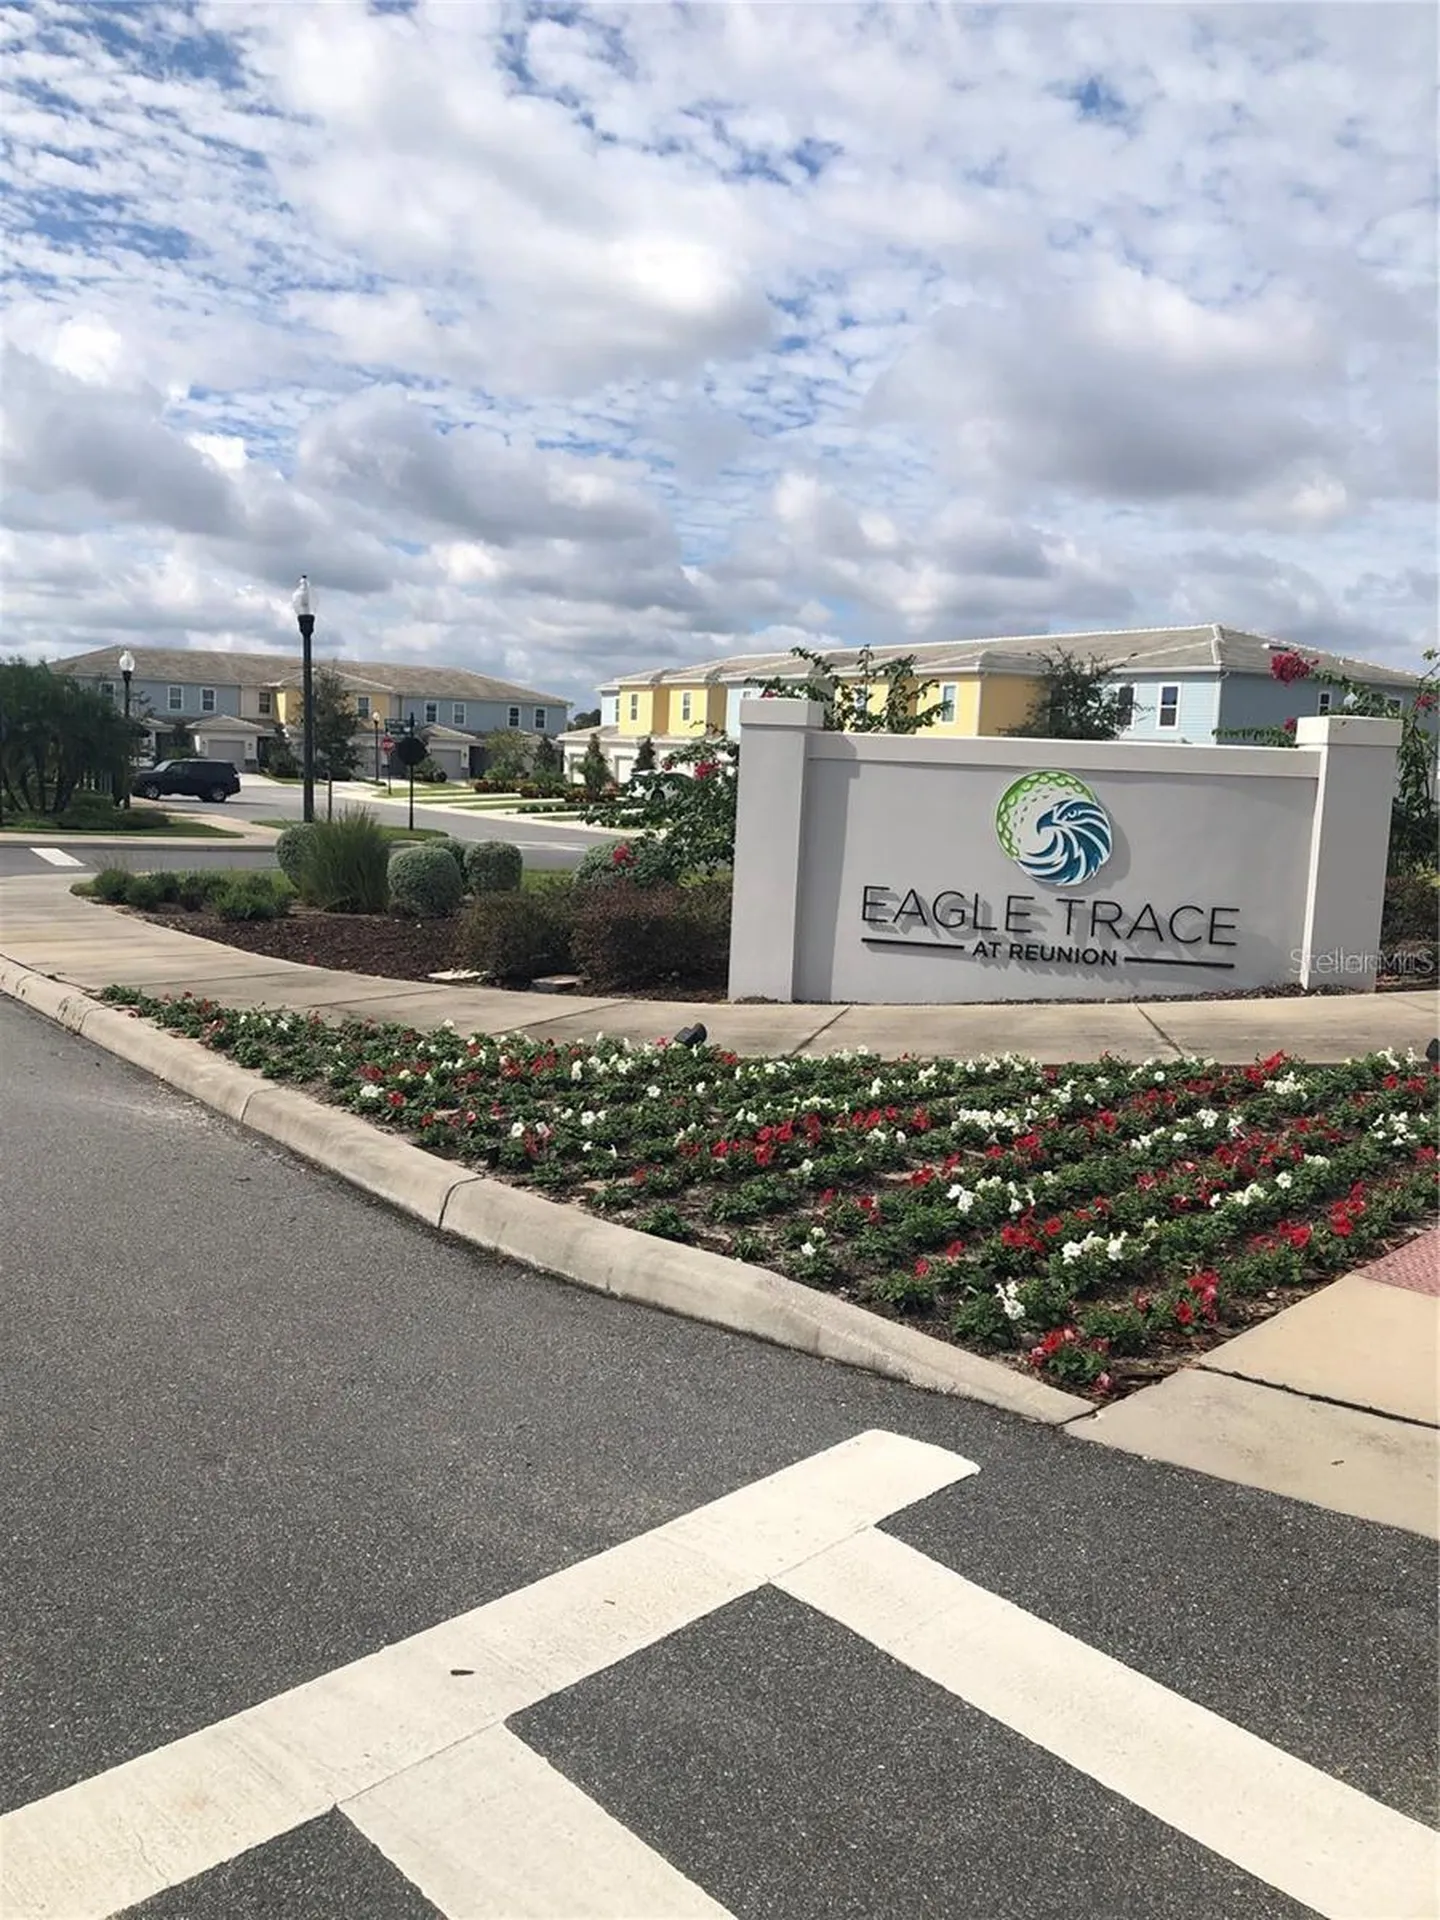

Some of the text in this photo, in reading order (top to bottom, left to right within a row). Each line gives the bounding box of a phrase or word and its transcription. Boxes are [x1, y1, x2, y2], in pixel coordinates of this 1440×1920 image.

[862, 885, 1241, 947] EAGLE TRACE
[972, 940, 1118, 967] AT REUNION
